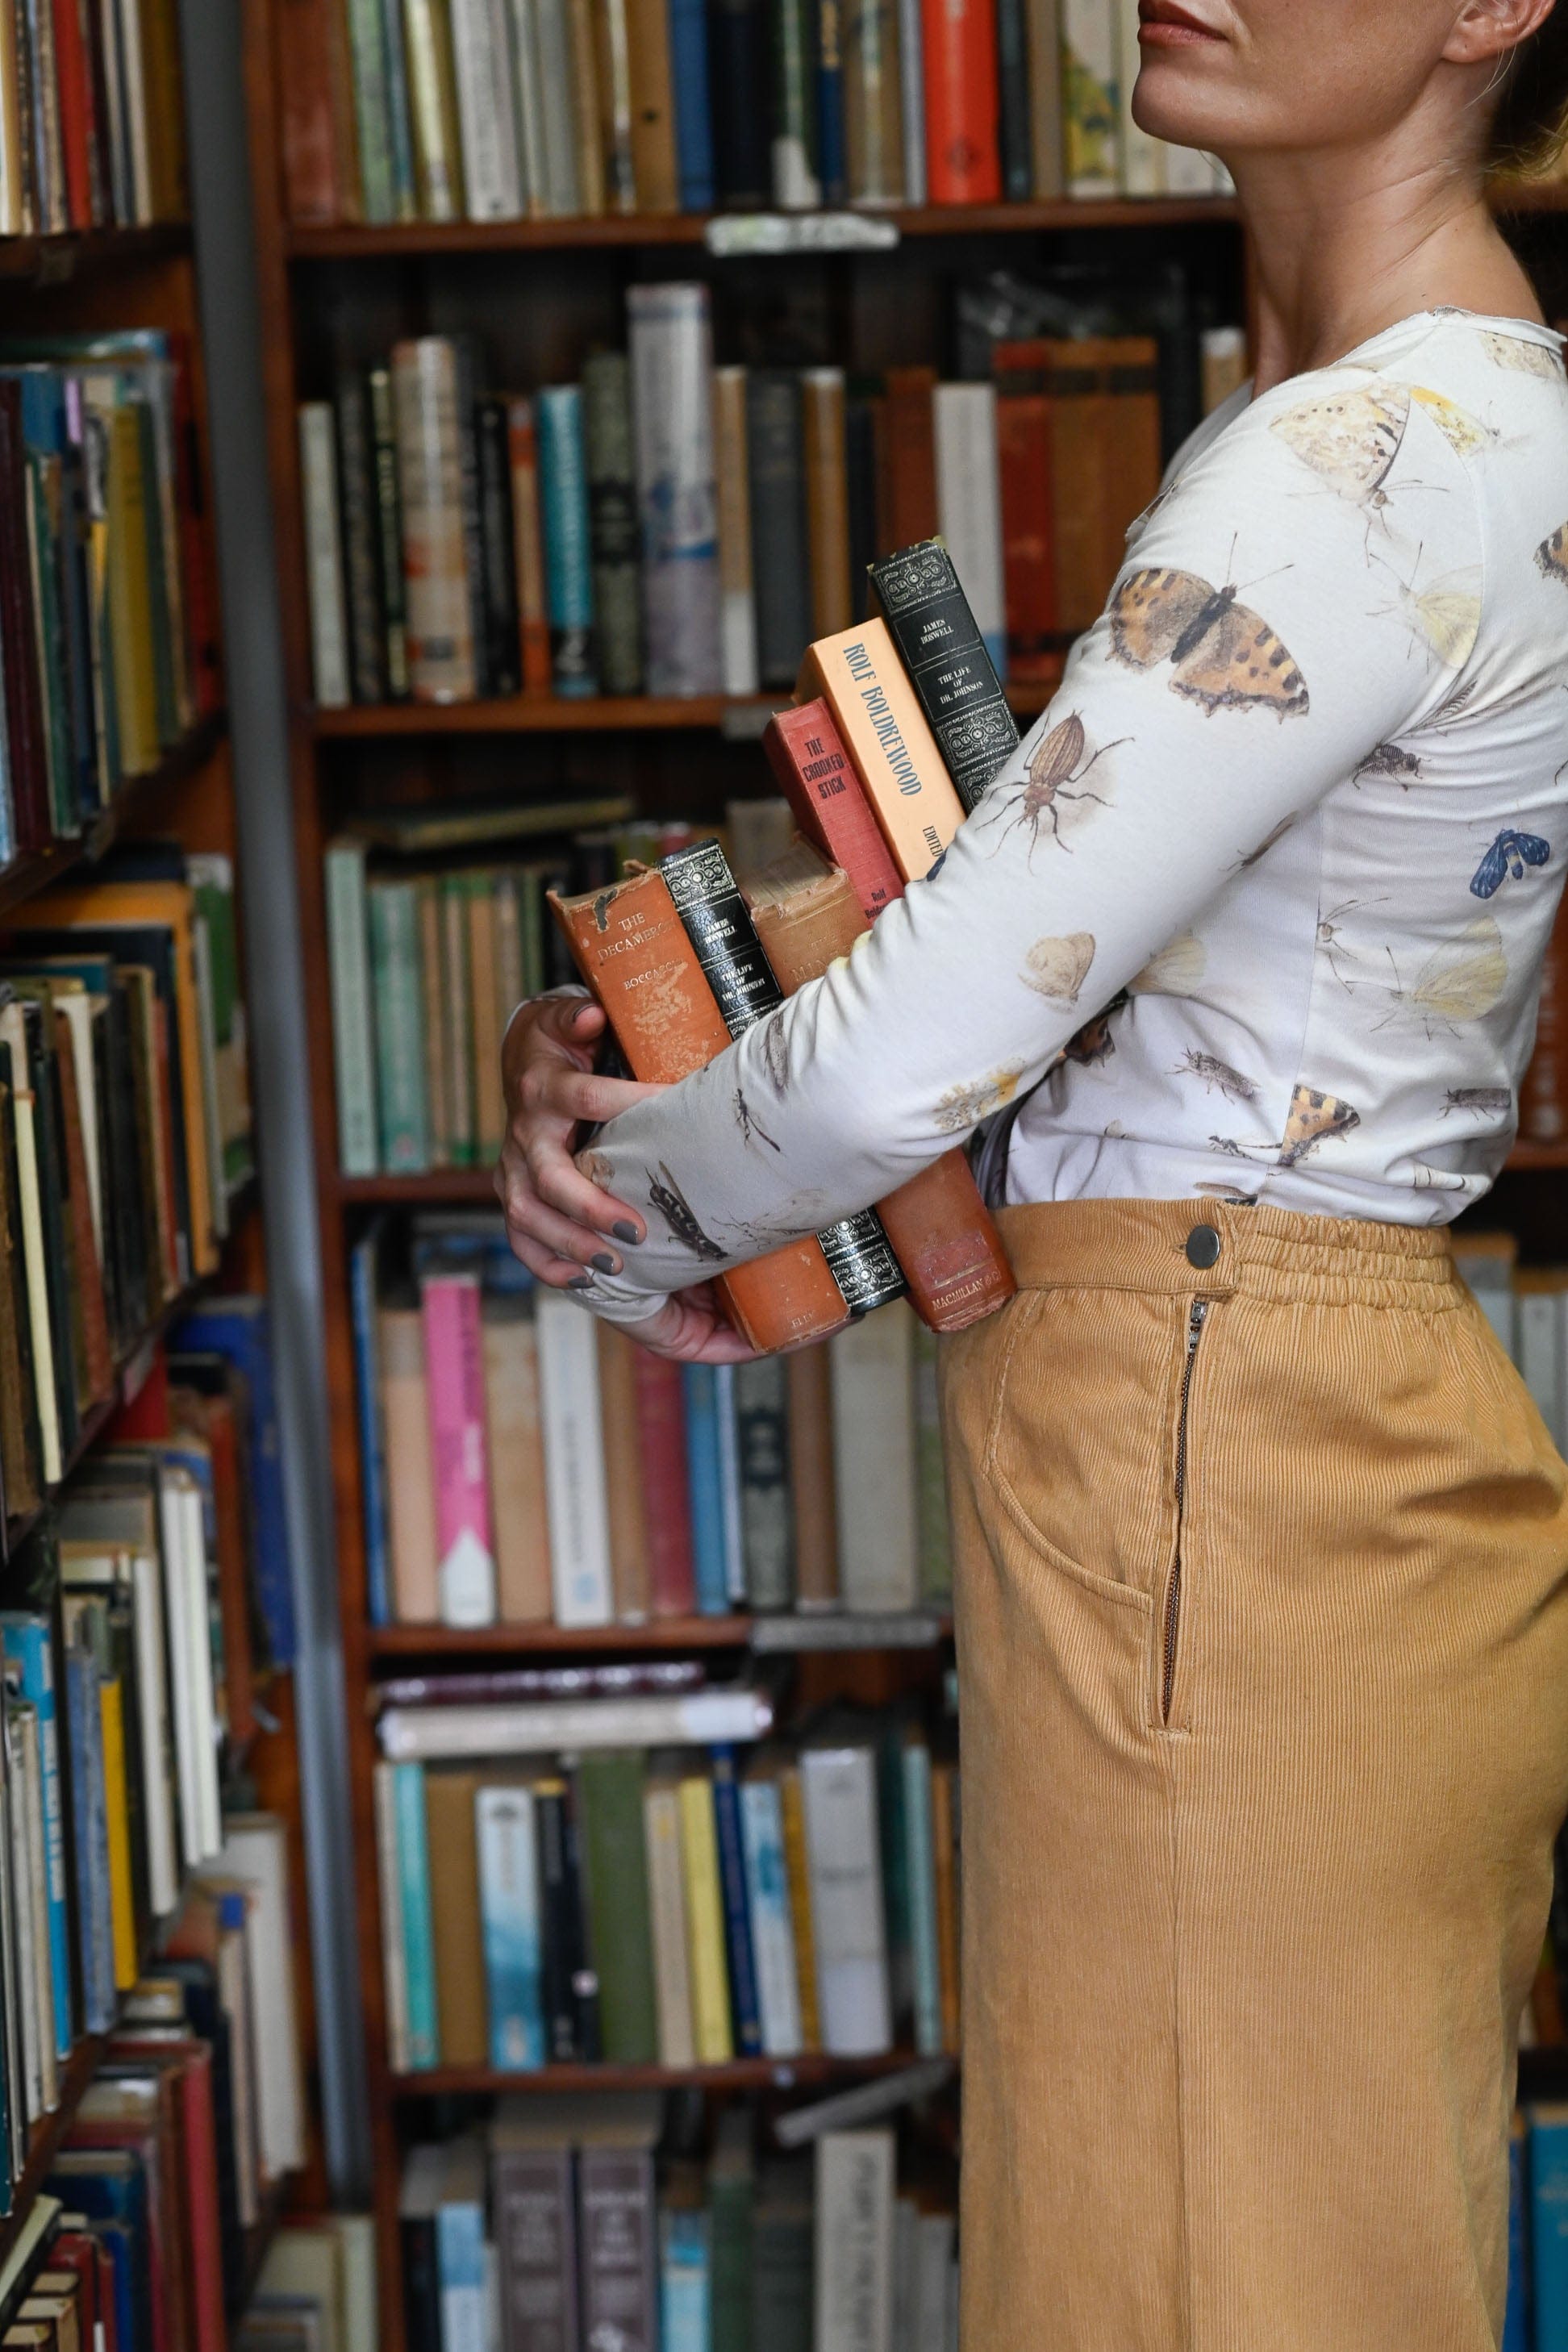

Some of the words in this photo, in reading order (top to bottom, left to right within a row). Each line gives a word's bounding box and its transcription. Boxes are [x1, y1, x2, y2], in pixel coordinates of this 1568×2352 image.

[920, 625, 954, 644] BOSWELL
[923, 619, 946, 633] JAMES
[937, 673, 954, 685] THE
[954, 666, 972, 678] LIFE
[953, 678, 962, 688] OF
[940, 694, 953, 704] DR.
[953, 681, 983, 699] JOHNSON
[843, 643, 877, 682] ROLF
[861, 686, 923, 795] BOLDREWOOD
[804, 737, 825, 757] THE
[802, 753, 845, 782] CROOKED
[818, 775, 847, 799] STICK
[922, 825, 943, 857] EDITED
[871, 887, 886, 903] Rolf
[618, 912, 645, 932] THE
[707, 918, 729, 932] JAMES
[597, 918, 674, 961] DECAMERO
[721, 969, 737, 982] THE
[736, 963, 754, 976] LIFE
[736, 975, 745, 986] OF
[932, 1278, 983, 1311] MACMILLAN
